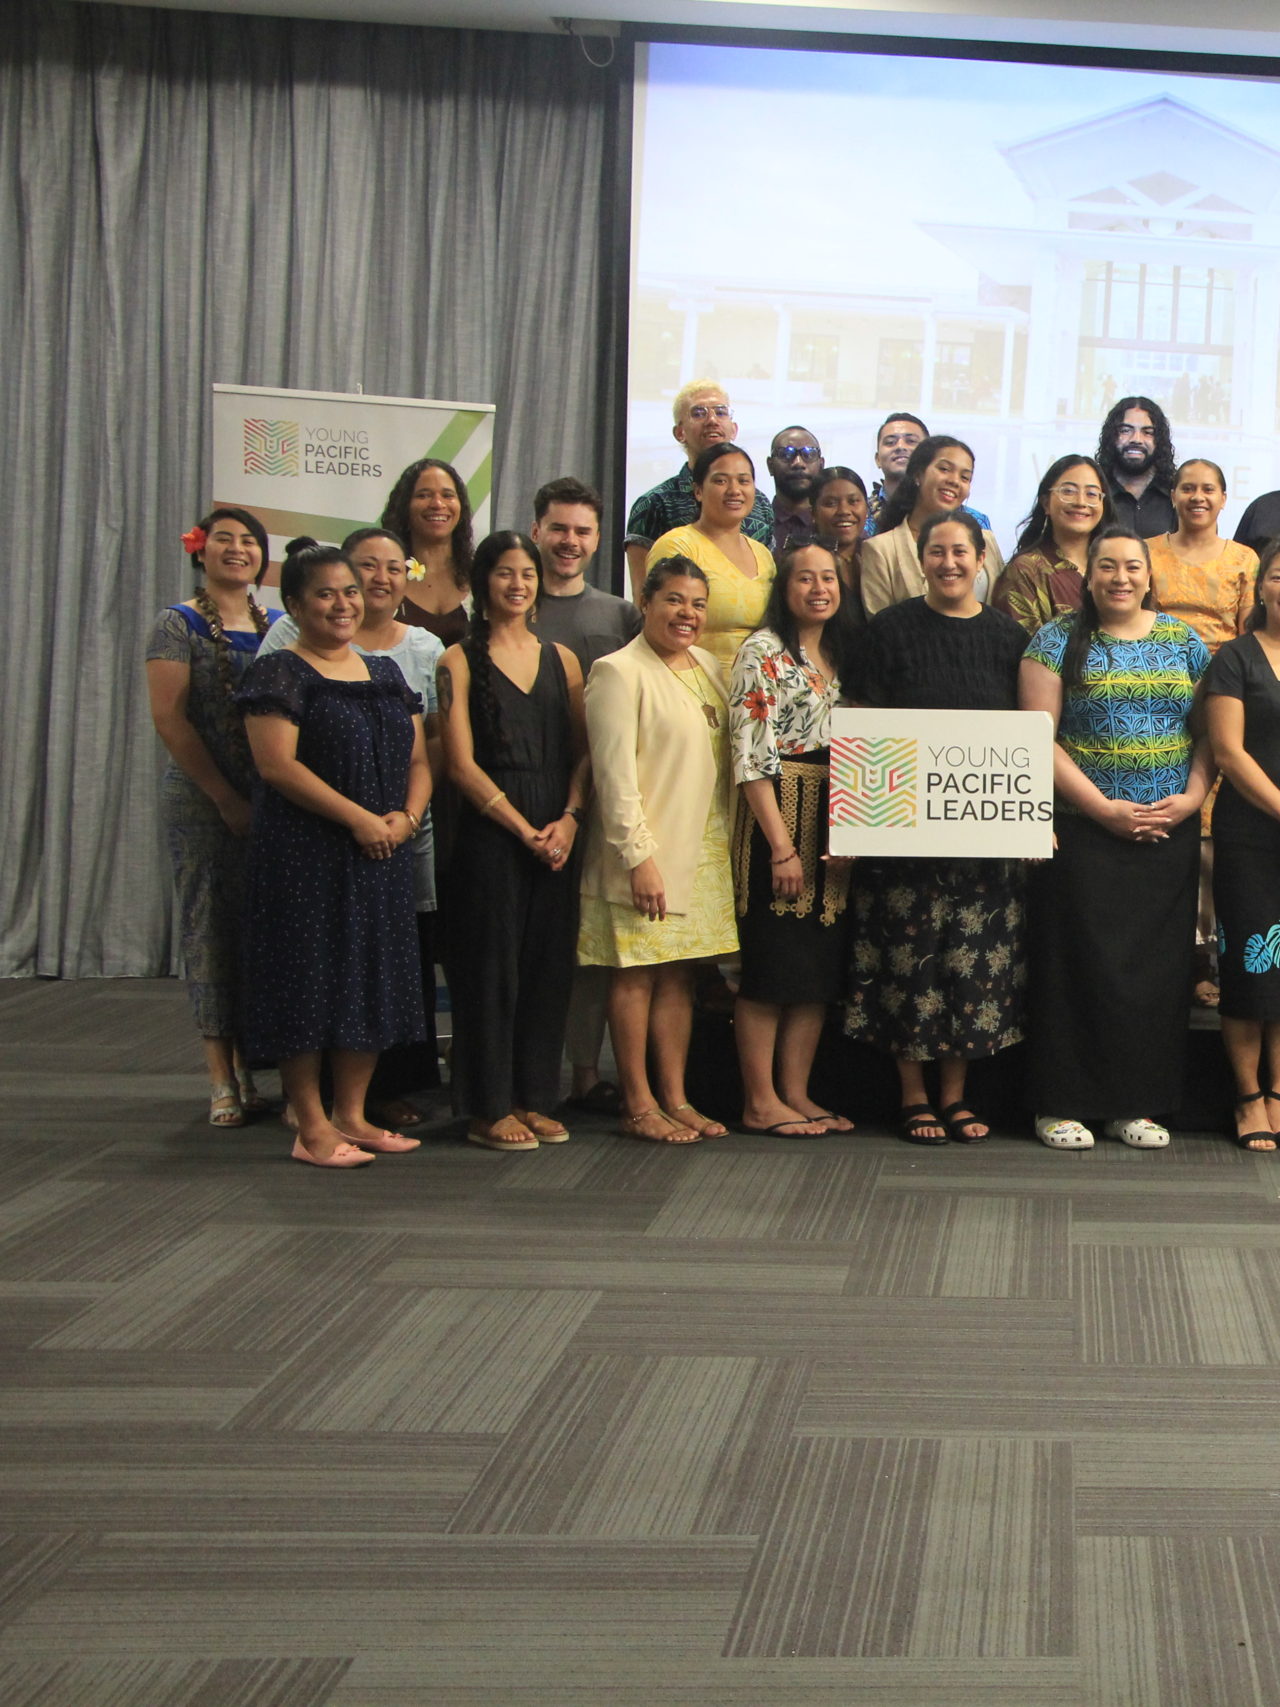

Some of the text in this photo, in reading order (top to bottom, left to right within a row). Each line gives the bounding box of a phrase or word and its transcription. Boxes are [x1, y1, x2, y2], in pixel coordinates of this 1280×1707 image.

[305, 427, 369, 444] YOUNG
[305, 443, 370, 461] PACIFIC
[305, 460, 382, 478] LEADERS
[928, 745, 1030, 768] YOUNG
[927, 772, 1031, 795] PACIFIC
[927, 799, 1053, 822] LEADERS
